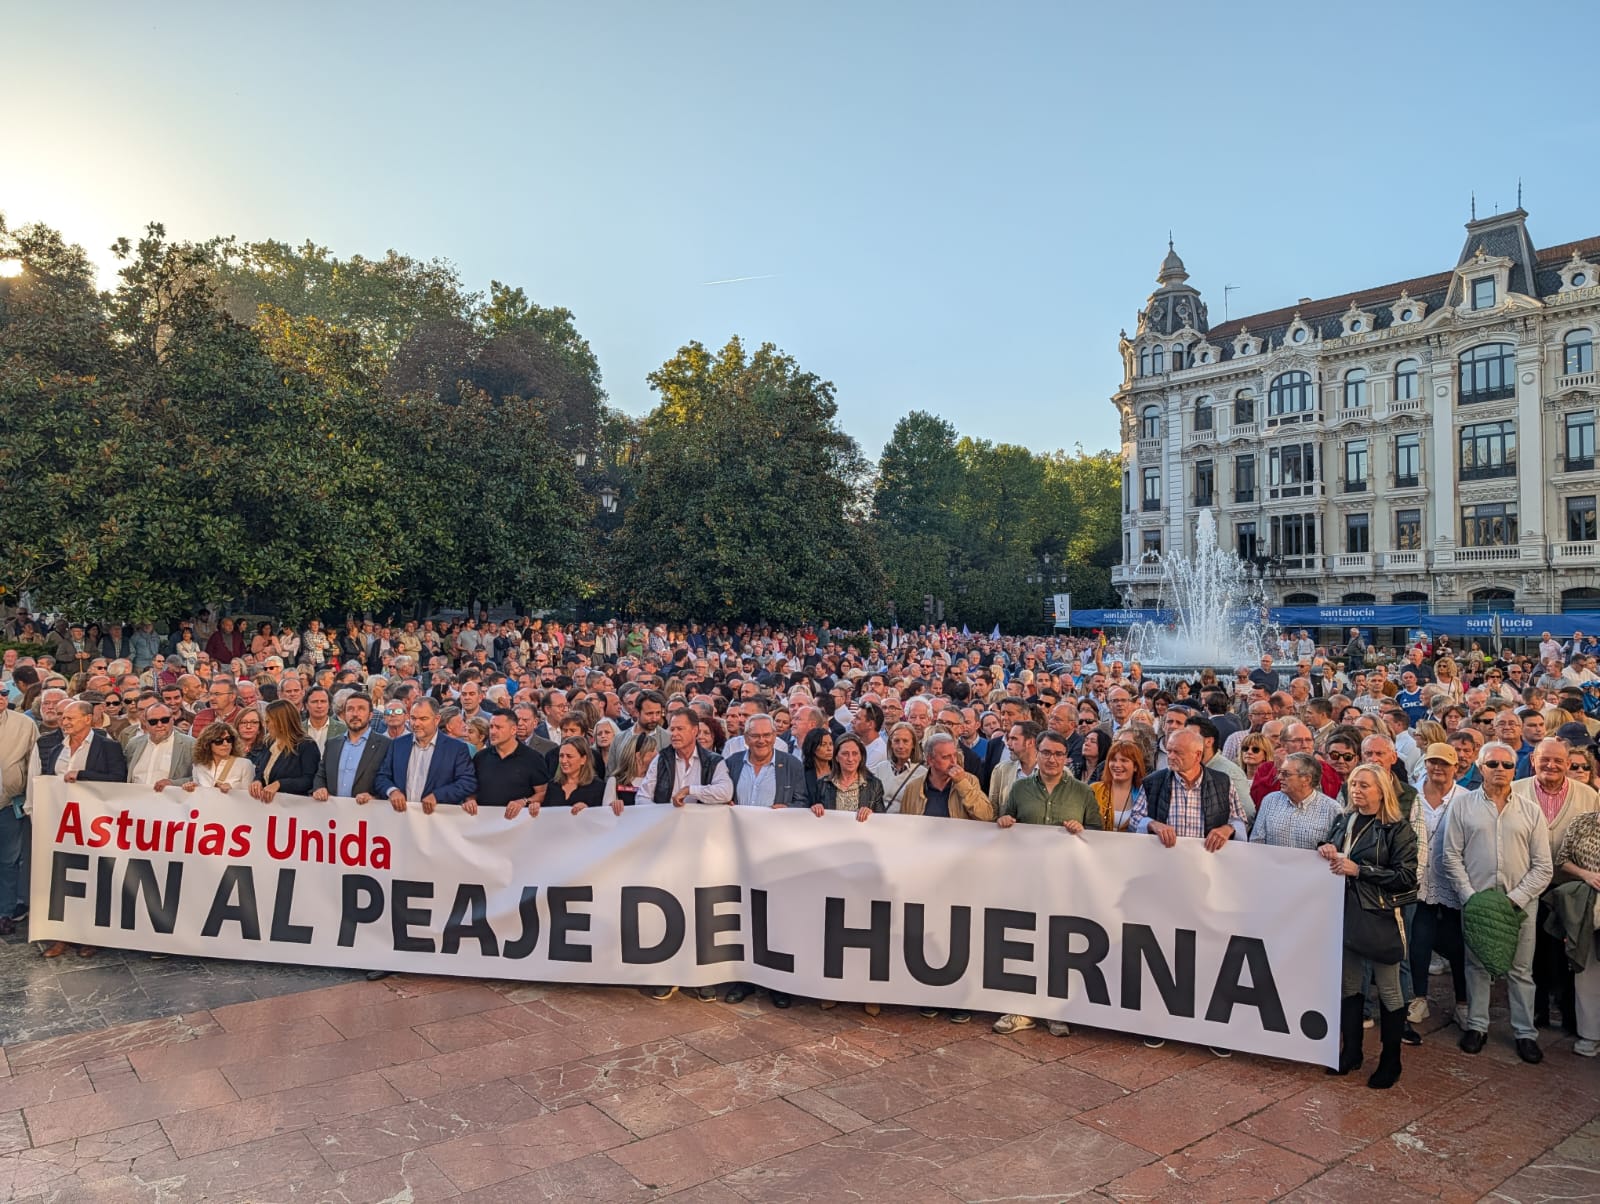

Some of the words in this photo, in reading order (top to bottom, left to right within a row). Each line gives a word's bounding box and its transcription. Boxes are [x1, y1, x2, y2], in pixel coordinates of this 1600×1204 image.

[1320, 608, 1375, 617] santalucía
[1466, 617, 1533, 627] santlucía
[55, 801, 252, 858] Asturias
[267, 815, 391, 870] Unida
[48, 850, 184, 934] FIN
[200, 865, 314, 944] AL
[337, 874, 593, 963] PEAJE
[620, 884, 795, 973] DEL
[823, 896, 1329, 1041] HUERNA.
